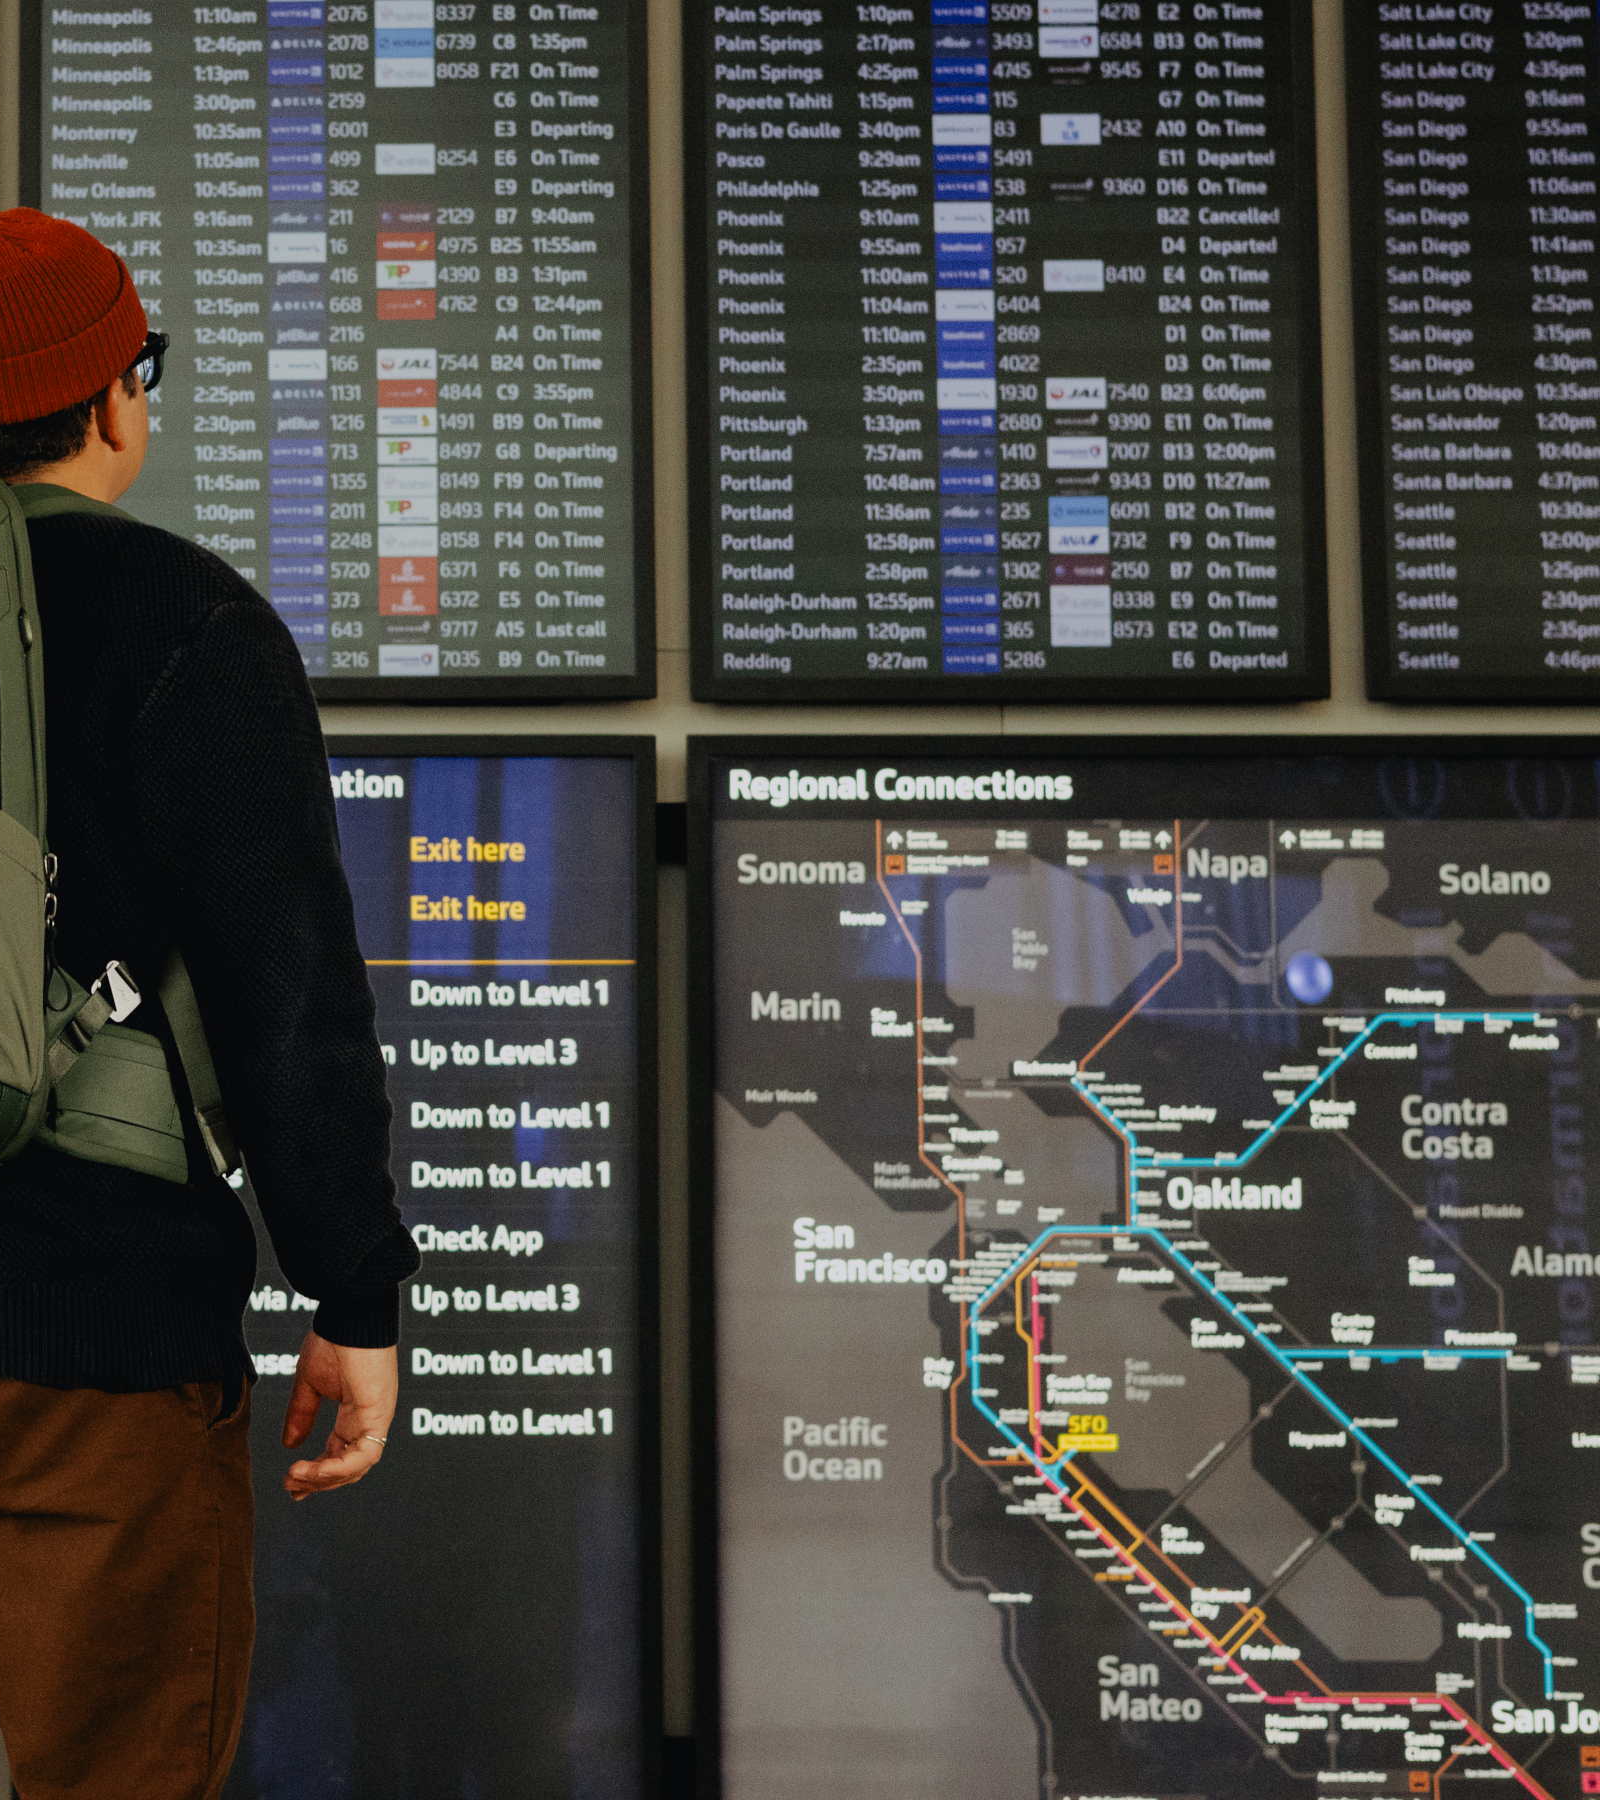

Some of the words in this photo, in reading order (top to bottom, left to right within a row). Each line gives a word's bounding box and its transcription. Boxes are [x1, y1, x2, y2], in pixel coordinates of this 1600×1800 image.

[52, 125, 137, 143] Monterrey
[194, 123, 261, 139] 10:35am
[328, 122, 368, 137] 6001
[495, 121, 516, 137] E3
[531, 120, 613, 139] Departing
[52, 154, 128, 169] Nashville
[194, 152, 259, 168] 11:05am
[329, 151, 361, 166] 499
[436, 150, 477, 166] 8254
[495, 150, 516, 166] E6
[531, 149, 555, 165] On
[561, 149, 599, 165] Time
[717, 210, 783, 226] Phoenix
[860, 209, 919, 225] 9:10am
[1199, 208, 1279, 224] Cancelled
[1391, 385, 1422, 401] San
[1426, 385, 1461, 401] Luis
[1464, 384, 1523, 403] Obispo
[720, 416, 807, 435] Pittsburgh
[864, 415, 921, 434] 1:33pm
[999, 414, 1042, 430] 2680
[1108, 414, 1150, 429] 9390
[1165, 414, 1191, 430] E11
[1203, 414, 1228, 430] On
[1234, 413, 1273, 430] Time
[723, 653, 791, 673] Redding
[867, 652, 928, 669] 9:27am
[1004, 652, 1045, 667] 5286
[1172, 652, 1194, 668] E6
[1209, 651, 1287, 670] Departed
[729, 769, 869, 807] Regional
[874, 768, 1073, 800] Connections
[411, 837, 461, 861] Exit
[467, 837, 525, 862] here
[738, 854, 865, 884] Sonoma
[1187, 848, 1267, 885] Napa
[1439, 864, 1550, 894] Solano
[412, 896, 461, 920] Exit
[467, 895, 526, 921] here
[1128, 888, 1172, 905] Vallejo
[840, 911, 886, 925] Novato
[411, 980, 482, 1006] Down
[487, 983, 515, 1006] to
[520, 979, 591, 1006] Level
[595, 980, 608, 1005] 1
[752, 992, 840, 1020] Marin
[411, 1039, 447, 1070] Up
[451, 1042, 480, 1065] to
[485, 1039, 556, 1065] Level
[560, 1038, 577, 1065] 3
[1364, 1043, 1417, 1059] Concord
[1509, 1035, 1559, 1049] Antioch
[1014, 1060, 1079, 1078] Richmond
[411, 1102, 483, 1128] Down
[487, 1105, 517, 1128] to
[520, 1102, 592, 1131] Level
[596, 1102, 609, 1128] 1
[1159, 1105, 1216, 1122] Berkeley
[1401, 1095, 1507, 1126] Contra
[1402, 1128, 1493, 1160] Costa
[411, 1161, 483, 1188] Down
[488, 1164, 516, 1188] to
[521, 1161, 593, 1188] Level
[596, 1161, 610, 1187] 1
[1167, 1177, 1302, 1209] Oakland
[411, 1224, 488, 1251] Check
[491, 1225, 543, 1256] App
[793, 1217, 854, 1251] San
[795, 1251, 946, 1283] Francisco
[1511, 1246, 1600, 1276] Alam
[412, 1285, 449, 1316] Up
[452, 1287, 481, 1311] to
[486, 1284, 558, 1311] Level
[562, 1284, 579, 1311] 3
[412, 1348, 485, 1375] Down
[489, 1351, 518, 1375] to
[522, 1348, 594, 1375] Level
[598, 1348, 612, 1374] 1
[412, 1408, 485, 1435] Down
[489, 1411, 518, 1435] to
[523, 1408, 595, 1435] Level
[598, 1408, 612, 1434] 1
[784, 1417, 886, 1446] Pacific
[1066, 1414, 1107, 1435] SFO
[784, 1450, 882, 1480] Ocean
[1098, 1655, 1159, 1686] San
[1101, 1691, 1202, 1721] Mateo
[1492, 1700, 1553, 1733] San
[1561, 1700, 1600, 1733] Jo
